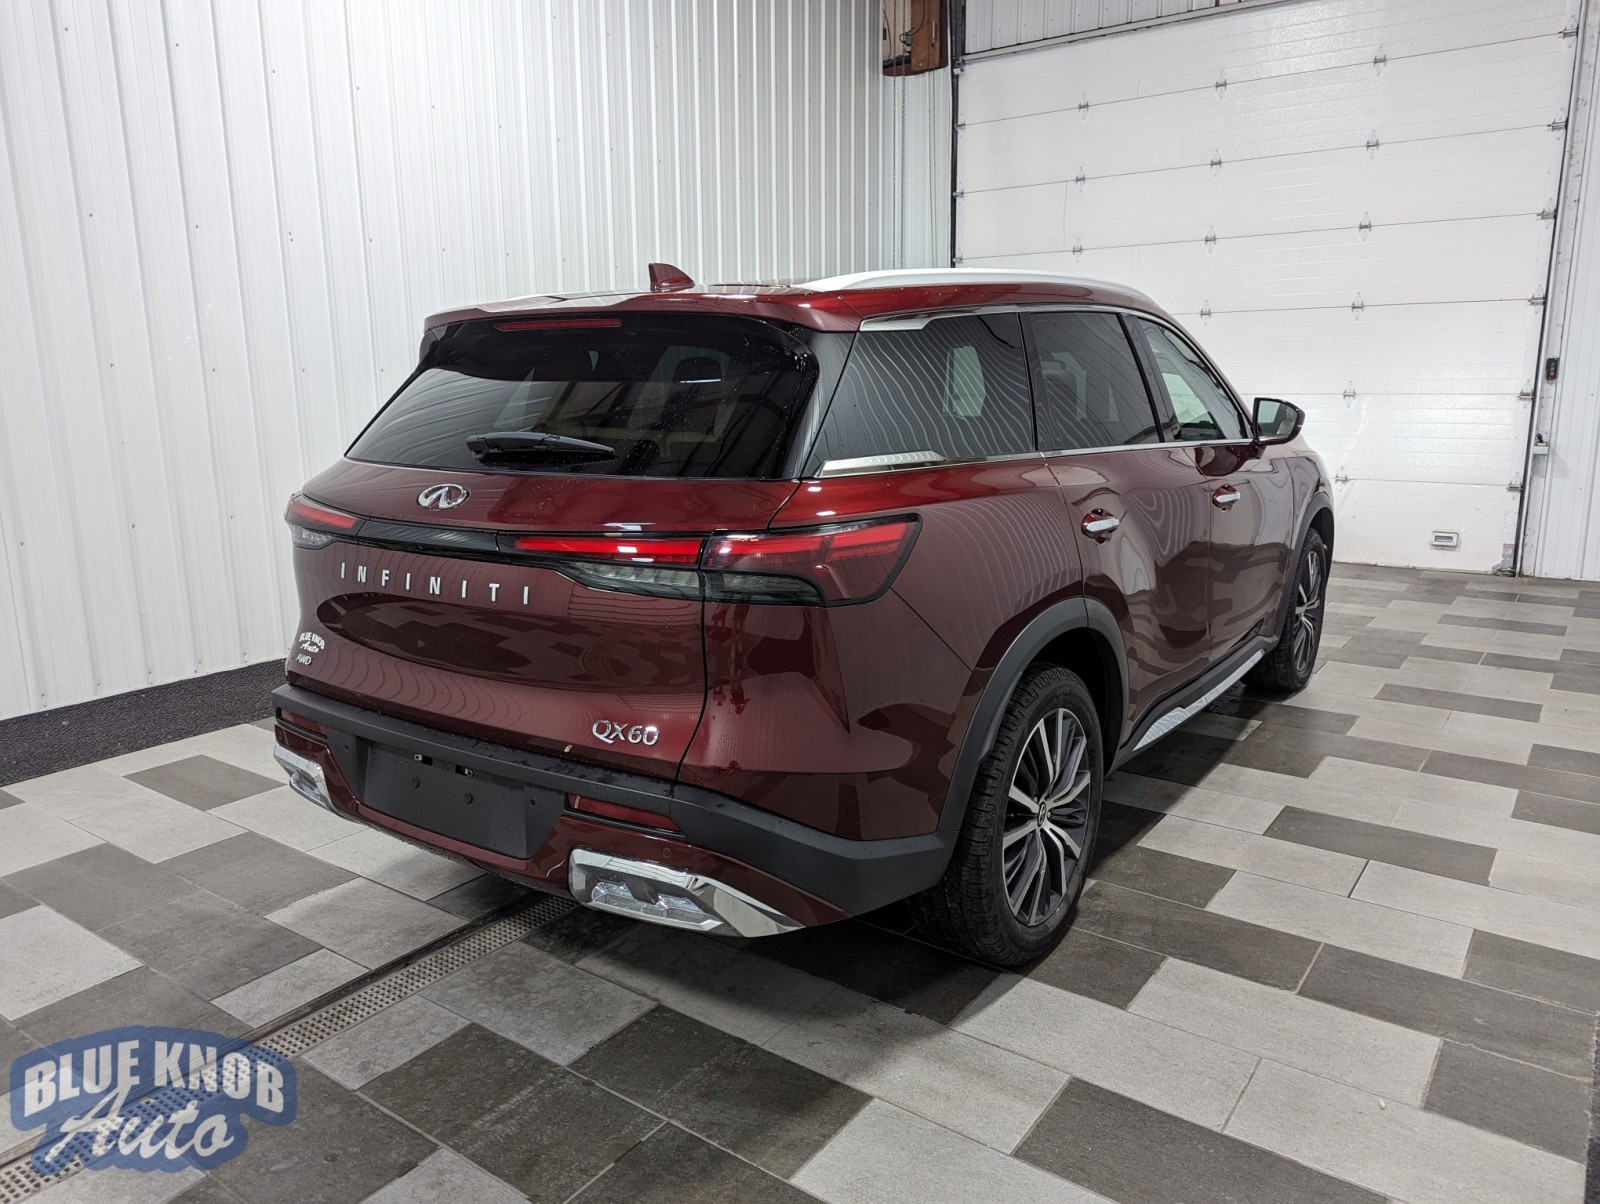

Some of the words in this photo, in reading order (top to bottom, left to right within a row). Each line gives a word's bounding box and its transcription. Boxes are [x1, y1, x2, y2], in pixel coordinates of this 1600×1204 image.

[341, 563, 529, 604] INFINITI
[299, 632, 312, 642] BLUE
[312, 633, 325, 649] KNOB
[300, 641, 319, 653] Auto
[296, 654, 312, 665] AWD
[591, 719, 660, 746] QX60
